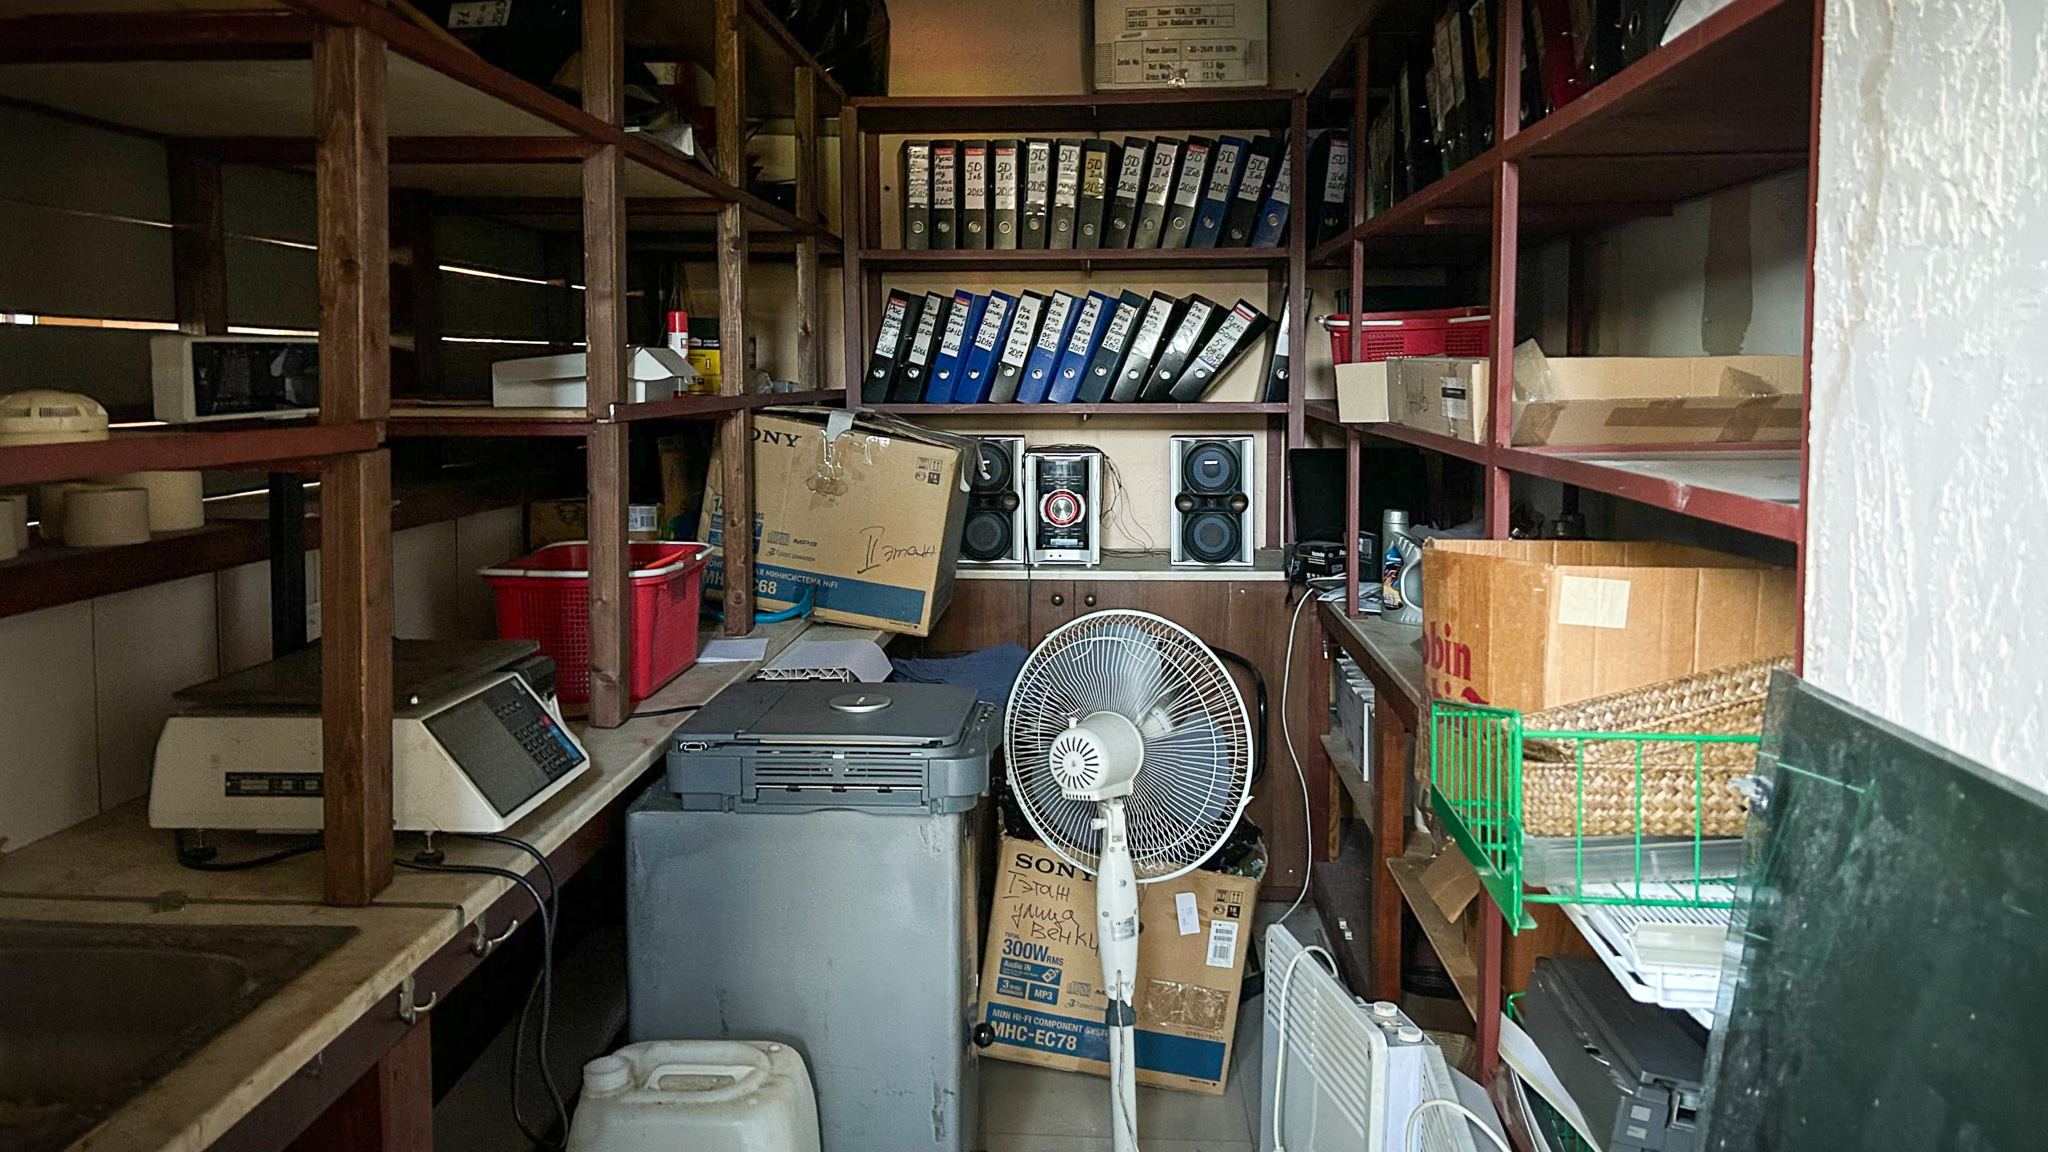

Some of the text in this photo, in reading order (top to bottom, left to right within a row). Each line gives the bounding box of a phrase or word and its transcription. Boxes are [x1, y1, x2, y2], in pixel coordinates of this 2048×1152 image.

[1157, 19, 1167, 27] Low
[1117, 58, 1130, 66] Serial
[750, 426, 802, 448] ONY
[793, 538, 818, 547] MP3
[882, 544, 935, 562] этаж
[765, 569, 821, 585] МИНИСИСТЕМА
[756, 579, 777, 594] 68
[1012, 903, 1079, 929] улица
[1002, 938, 1064, 966] 300W RMS
[1004, 960, 1023, 970] Audio
[1002, 980, 1010, 988] 3
[1034, 989, 1053, 1000] MP3
[992, 1009, 1010, 1020] MINI
[1013, 1013, 1032, 1023] HI-FI
[1033, 1017, 1083, 1033] COMPONENT
[991, 1021, 1077, 1051] MHC-EC78
